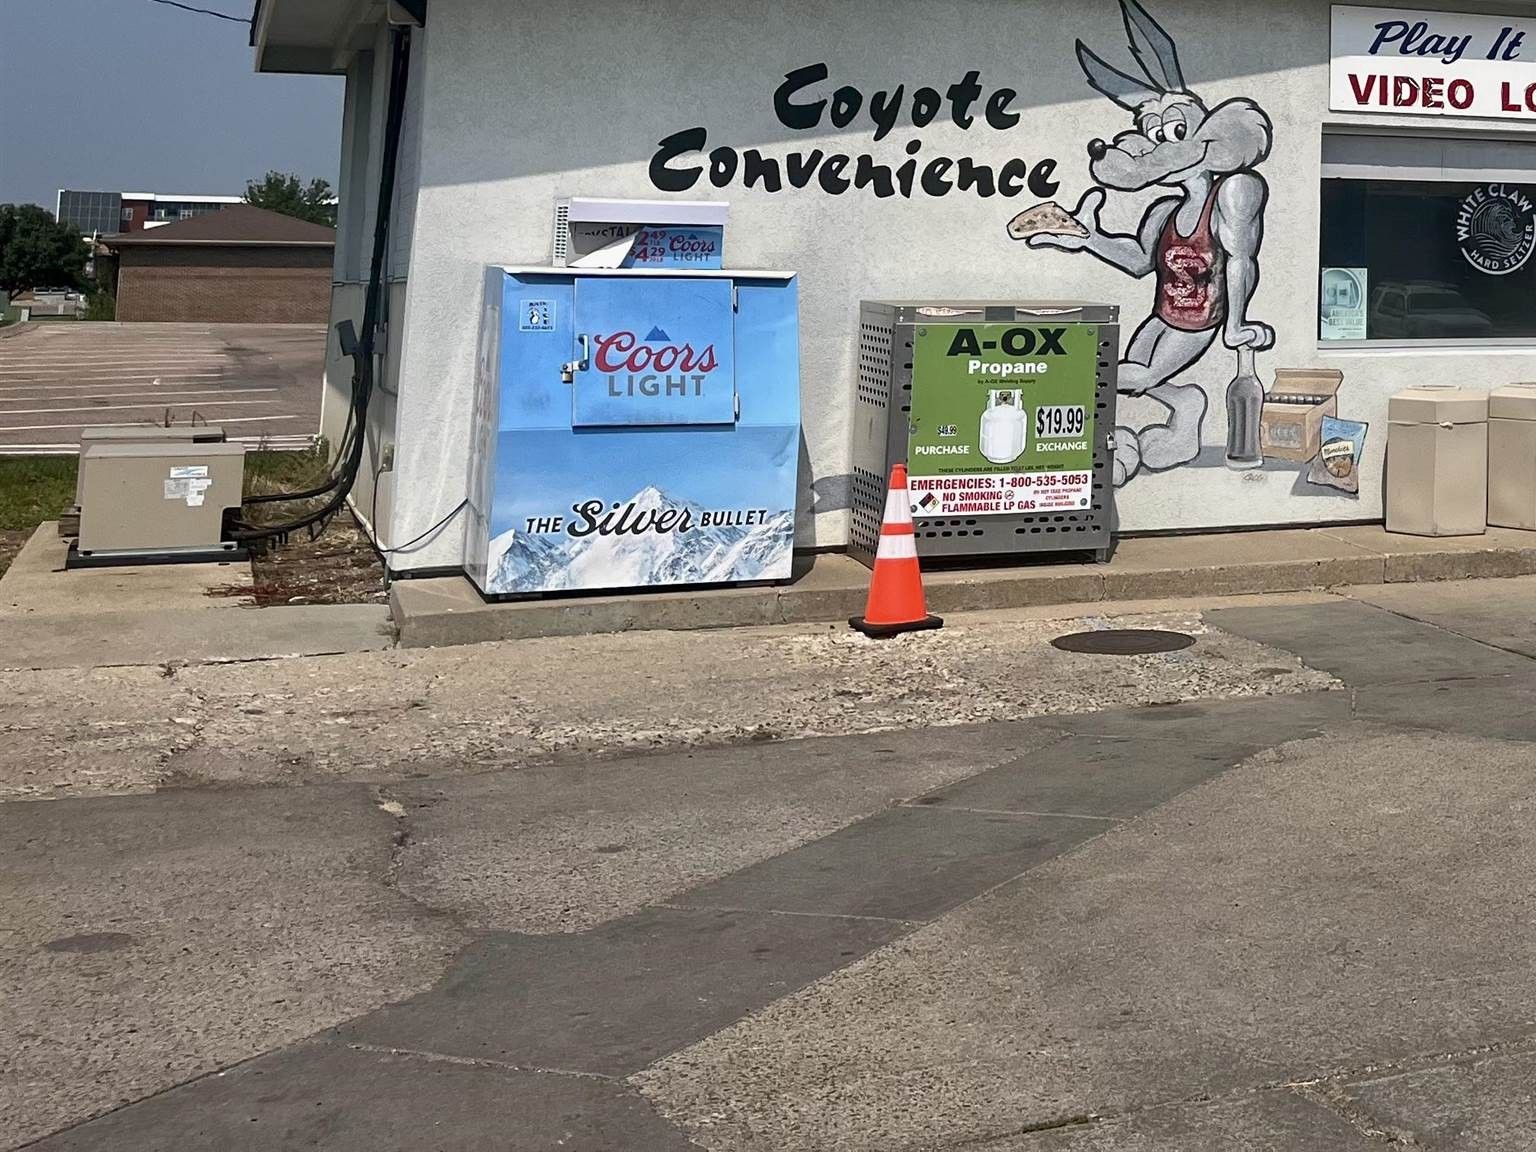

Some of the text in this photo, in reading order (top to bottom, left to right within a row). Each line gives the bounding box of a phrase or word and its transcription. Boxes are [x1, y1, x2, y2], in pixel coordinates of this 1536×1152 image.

[1368, 20, 1473, 65] Play
[1486, 26, 1525, 61] It
[773, 62, 1021, 142] Coyote
[1348, 74, 1475, 110] VIDEO
[648, 127, 1061, 199] Convenience
[1456, 183, 1533, 242] WHITE CLAW
[668, 234, 716, 253] Coors
[673, 253, 711, 262] LIGHT
[1470, 224, 1534, 269] HARD SELTZER
[594, 331, 720, 374] Coors
[947, 328, 1068, 357] A-OX
[968, 360, 1048, 377] Propane
[608, 374, 706, 397] LIGHT
[1037, 407, 1084, 438] $19.99
[915, 445, 970, 456] PURCHASE
[1036, 441, 1088, 453] EXCHANGE
[910, 474, 1088, 491] EMERGENCIES: 1-800-535-5053
[942, 491, 1003, 502] NO SMOKING
[526, 500, 767, 538] THE Silver BULLET
[942, 500, 1036, 513] FLAMMABLE LP GAS
